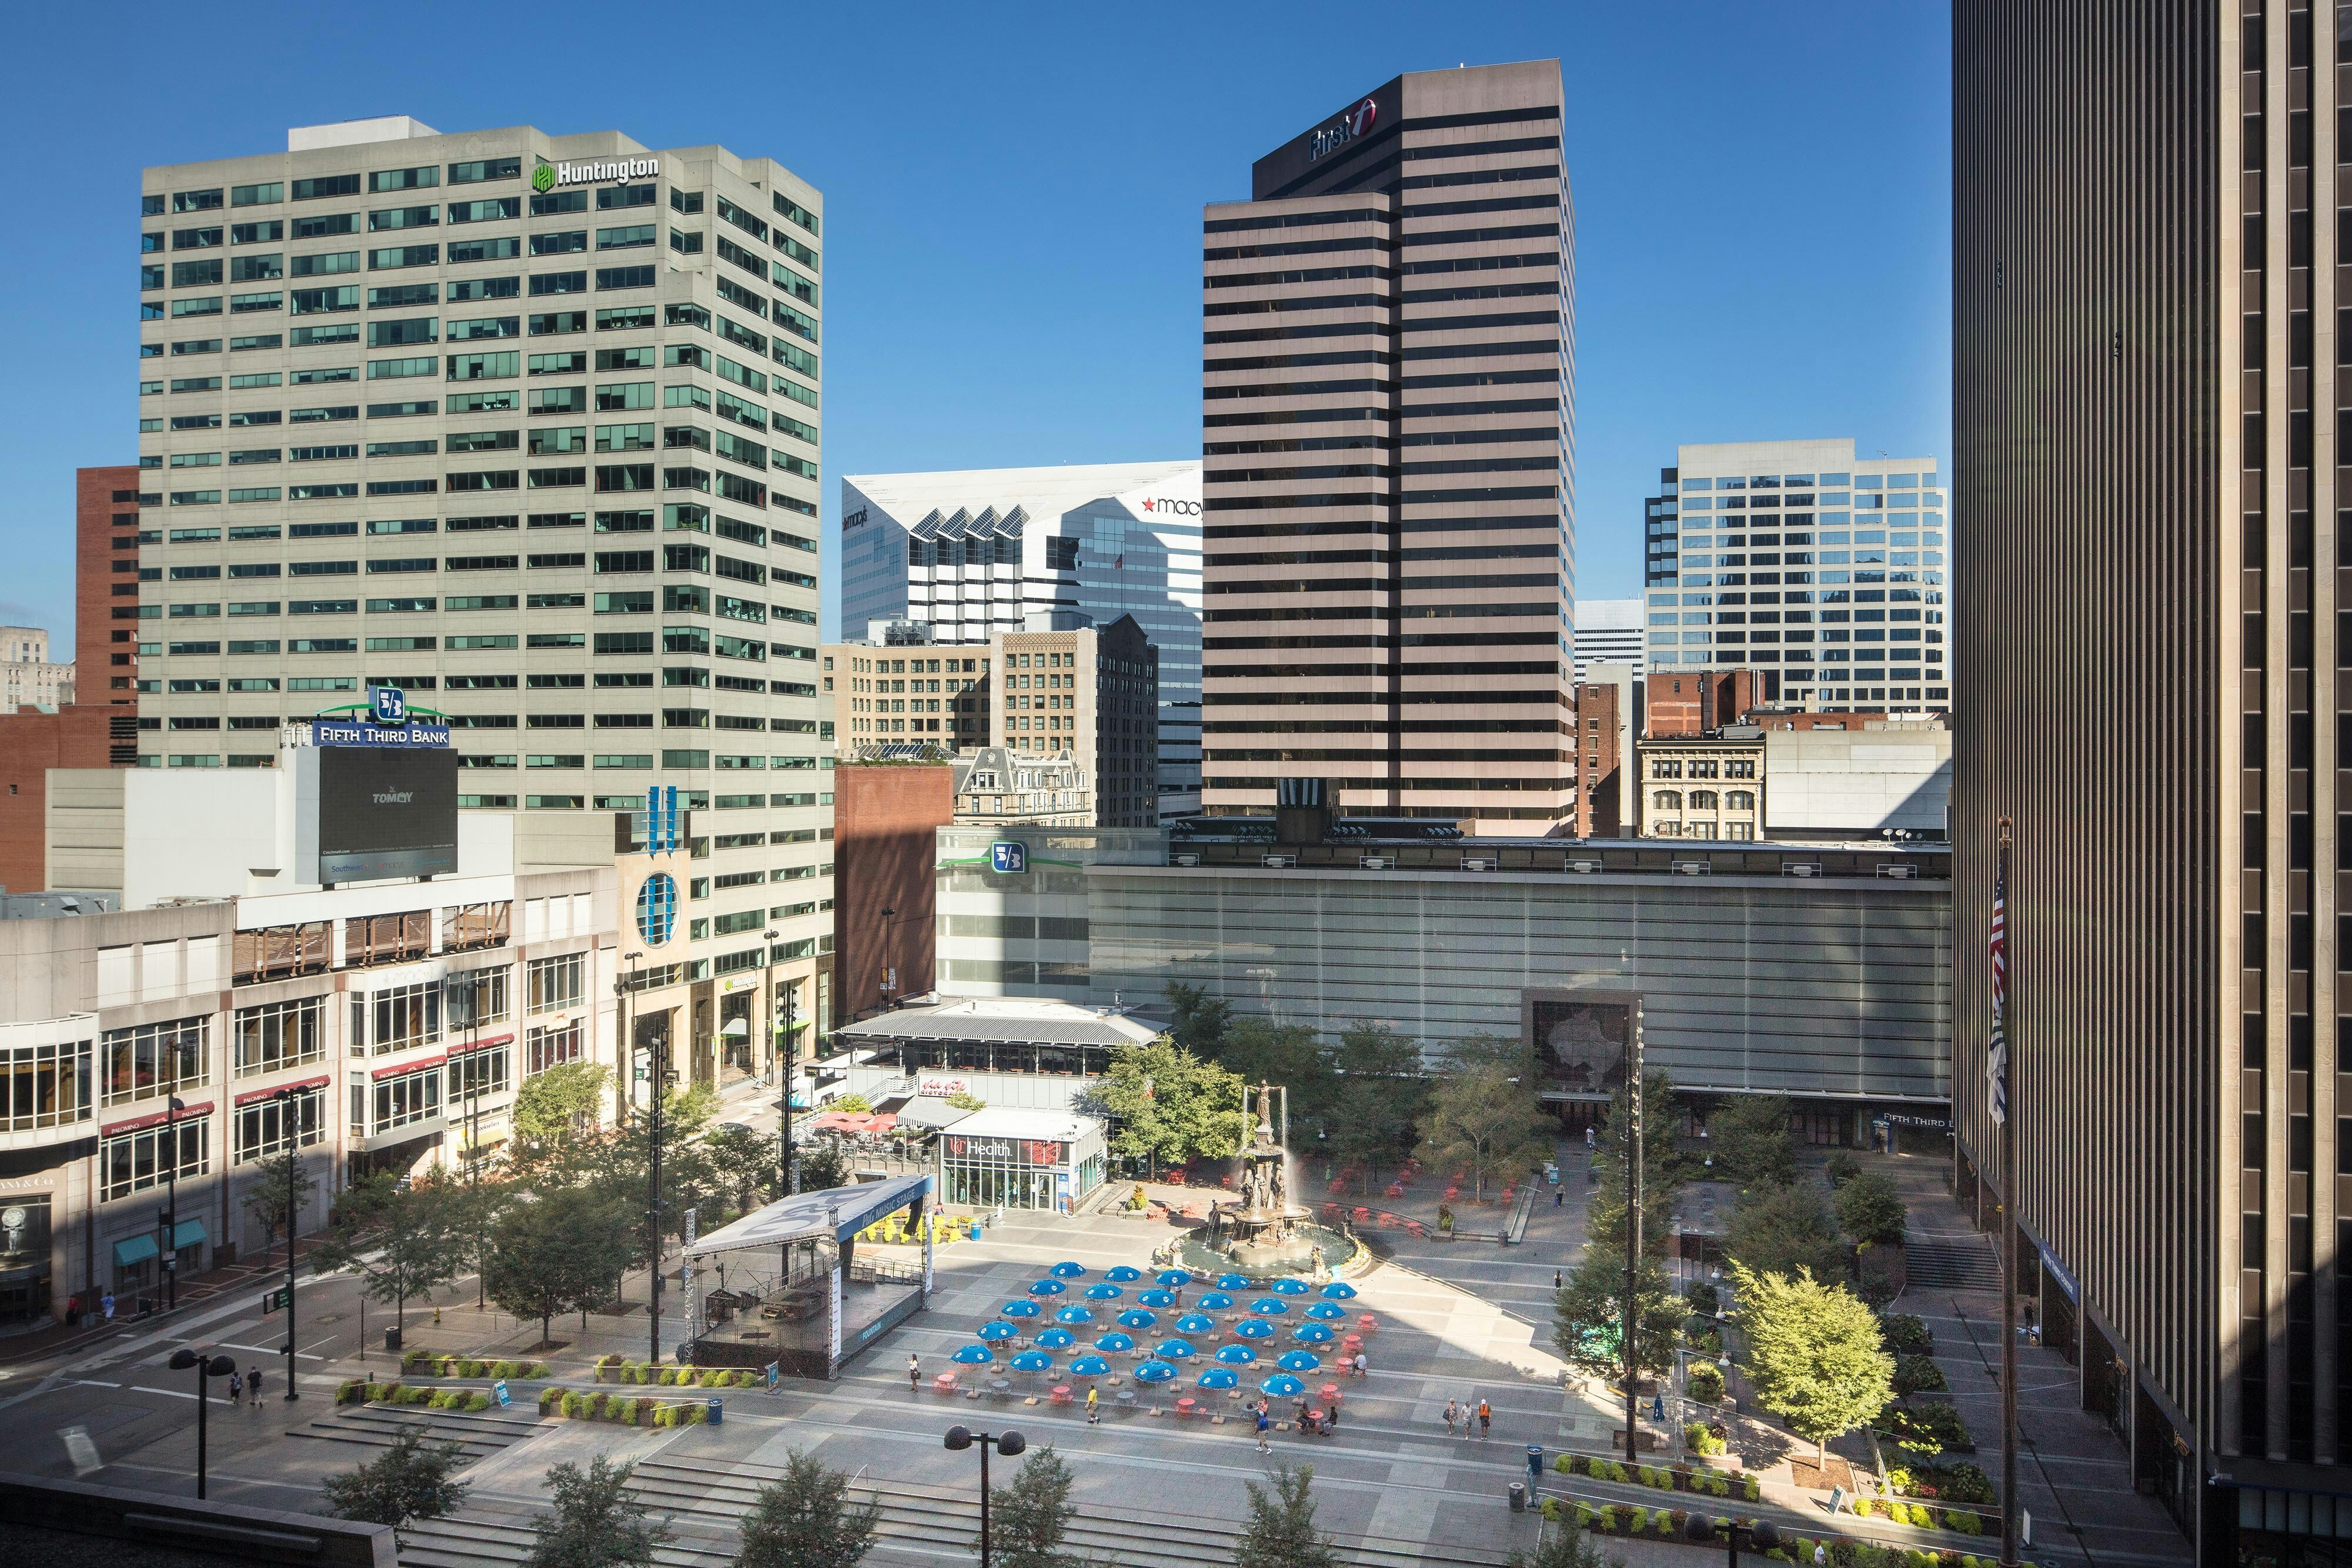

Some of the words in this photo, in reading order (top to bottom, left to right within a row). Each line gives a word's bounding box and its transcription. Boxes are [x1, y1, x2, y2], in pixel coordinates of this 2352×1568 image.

[1309, 115, 1351, 162] First
[558, 158, 659, 186] Huntington
[320, 727, 360, 741] FIFTH
[365, 728, 407, 743] THIRD
[412, 730, 447, 744] BANK
[493, 1037, 510, 1045] PALOMINO
[379, 1070, 400, 1079] PALOMINO
[425, 1059, 444, 1068] PALOMINO
[243, 1094, 268, 1104] PALOMINO
[305, 1080, 325, 1089] LOMINO
[111, 1123, 139, 1134] PALOMINO
[182, 1108, 208, 1118] PALOMINO
[1883, 1112, 1910, 1124] FIFTH
[1913, 1117, 1945, 1127] THIRD
[949, 1138, 967, 1155] UC
[23, 1179, 32, 1188] &
[861, 1209, 876, 1228] P&G
[876, 1199, 897, 1219] MUSIC
[897, 1188, 915, 1208] STAGE
